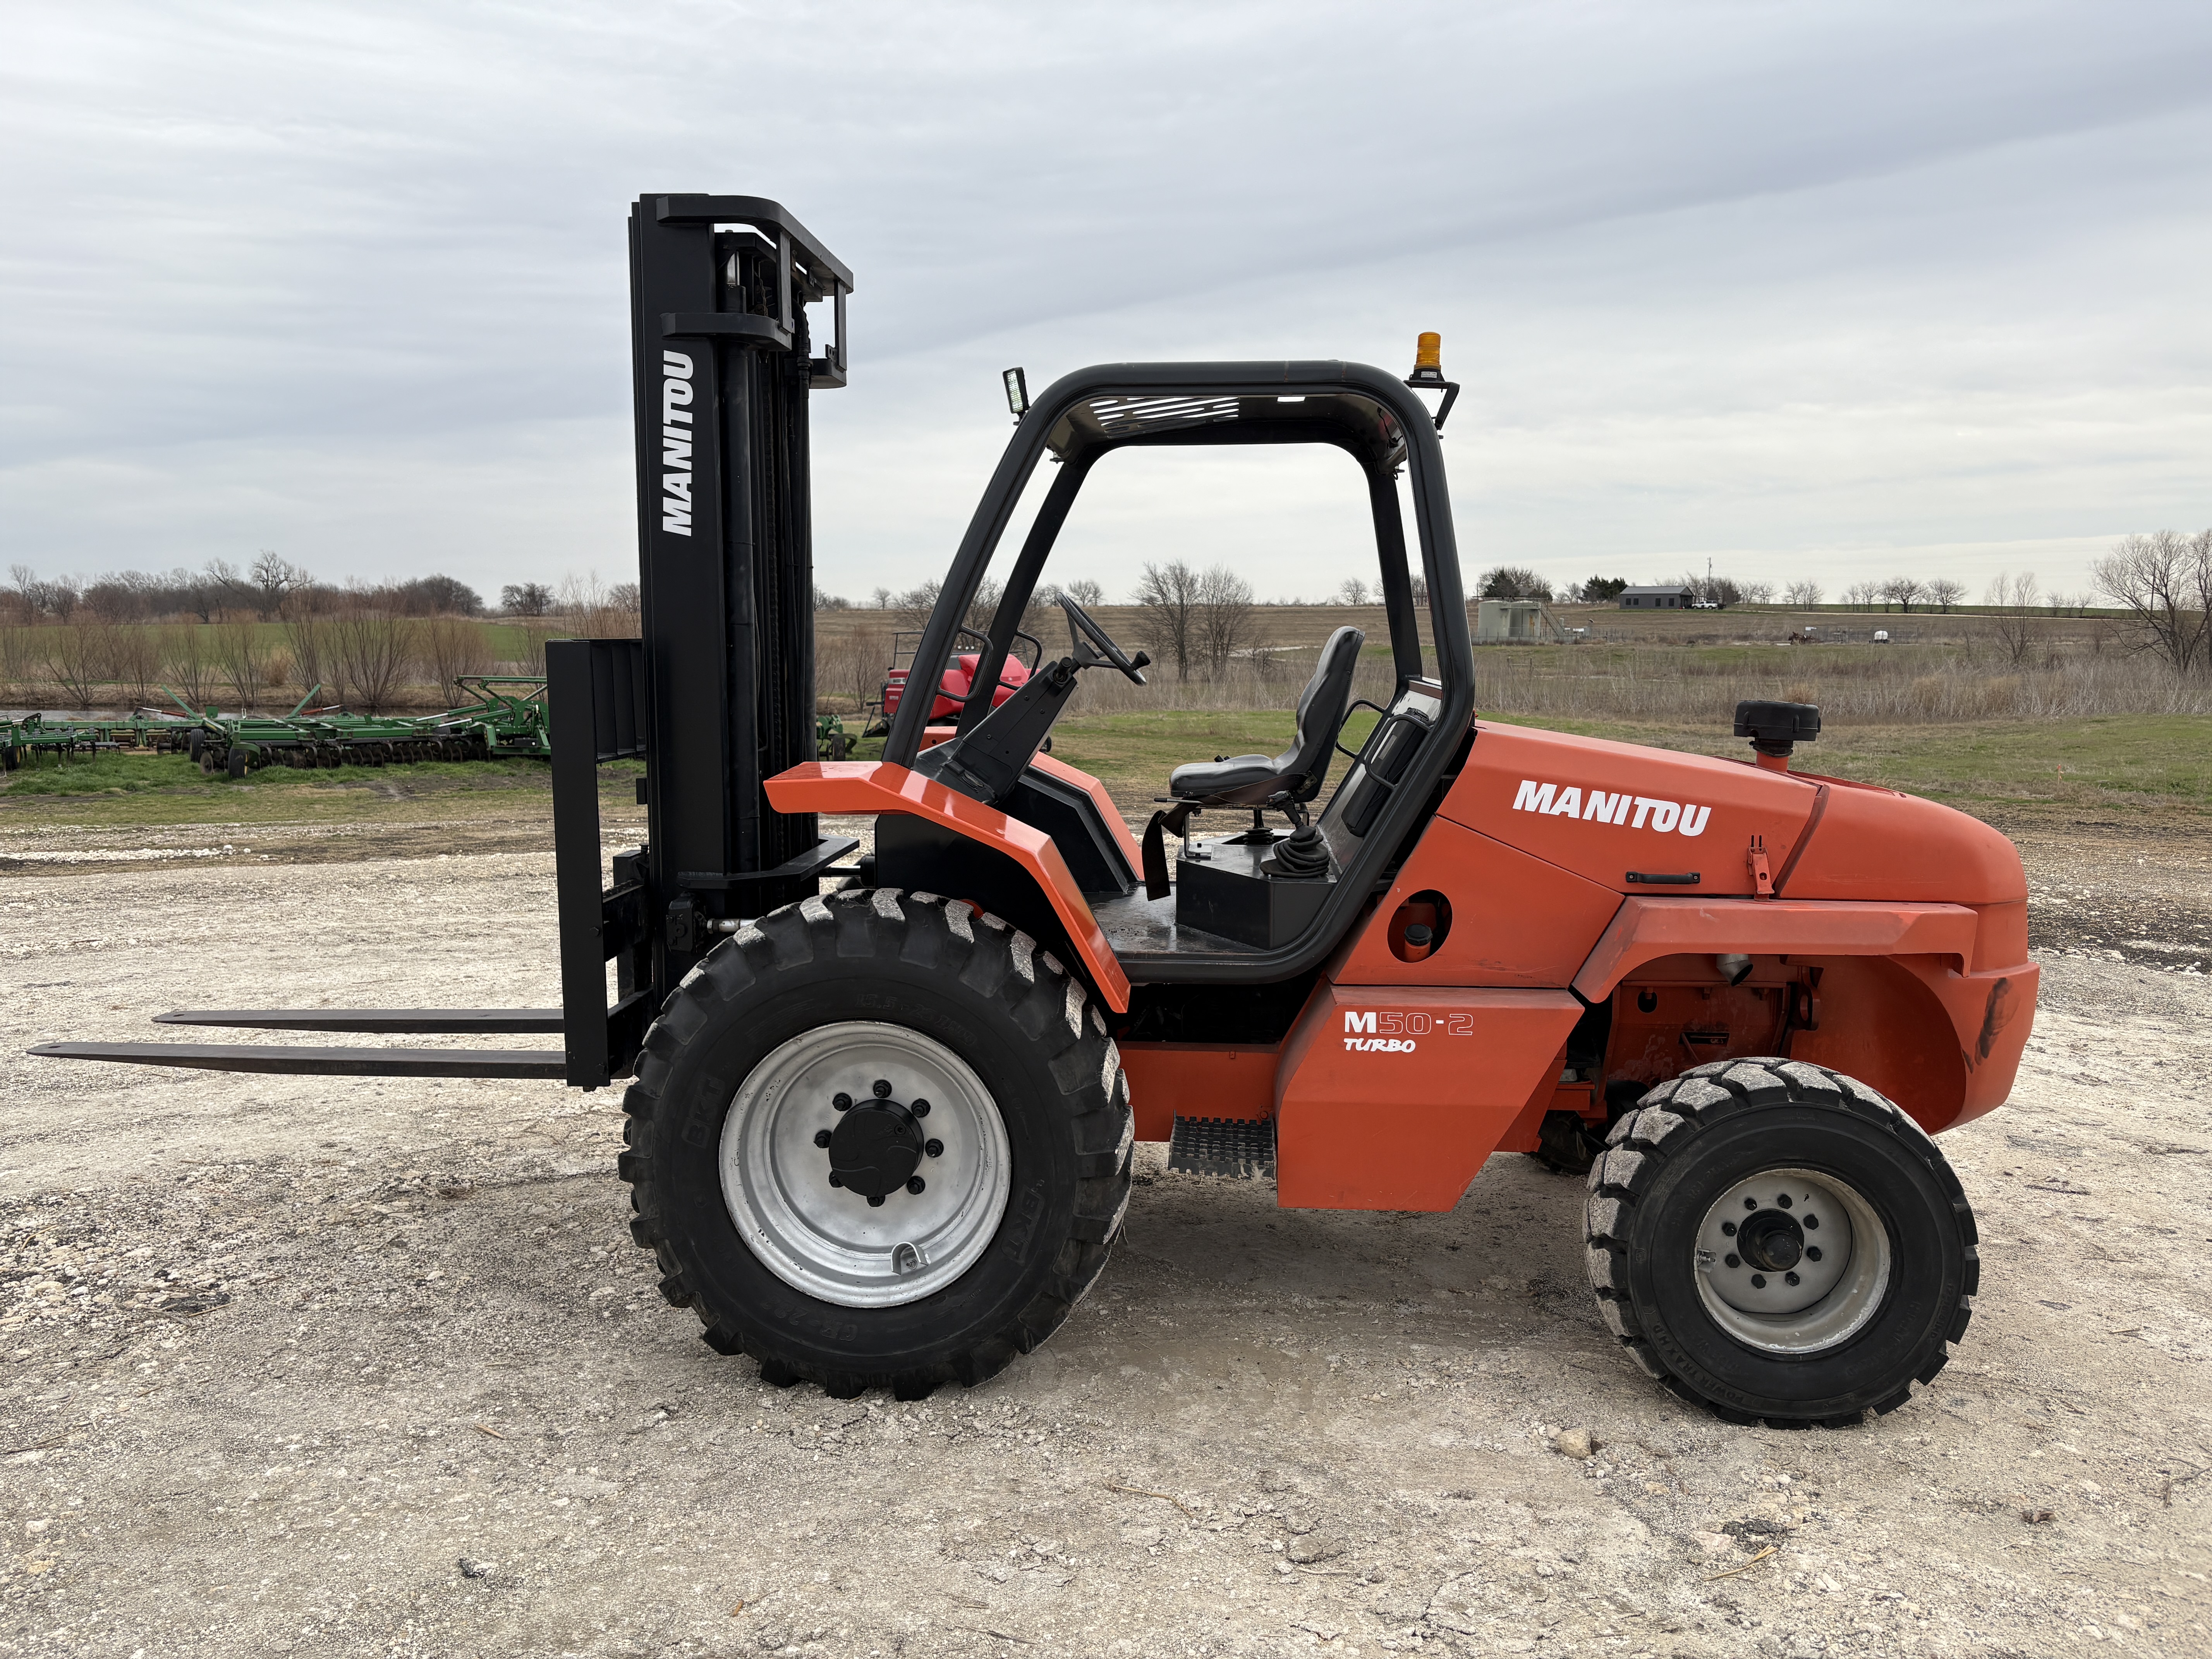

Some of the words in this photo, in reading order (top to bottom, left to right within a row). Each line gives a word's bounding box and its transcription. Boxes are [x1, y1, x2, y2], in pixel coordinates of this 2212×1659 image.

[663, 350, 693, 536] MANITOU
[1513, 780, 1711, 836] MANITOU
[1344, 1038, 1415, 1053] TURBO
[1345, 1012, 1473, 1036] M50-2
[685, 1076, 723, 1146] BKT
[1005, 1187, 1041, 1262] BKT
